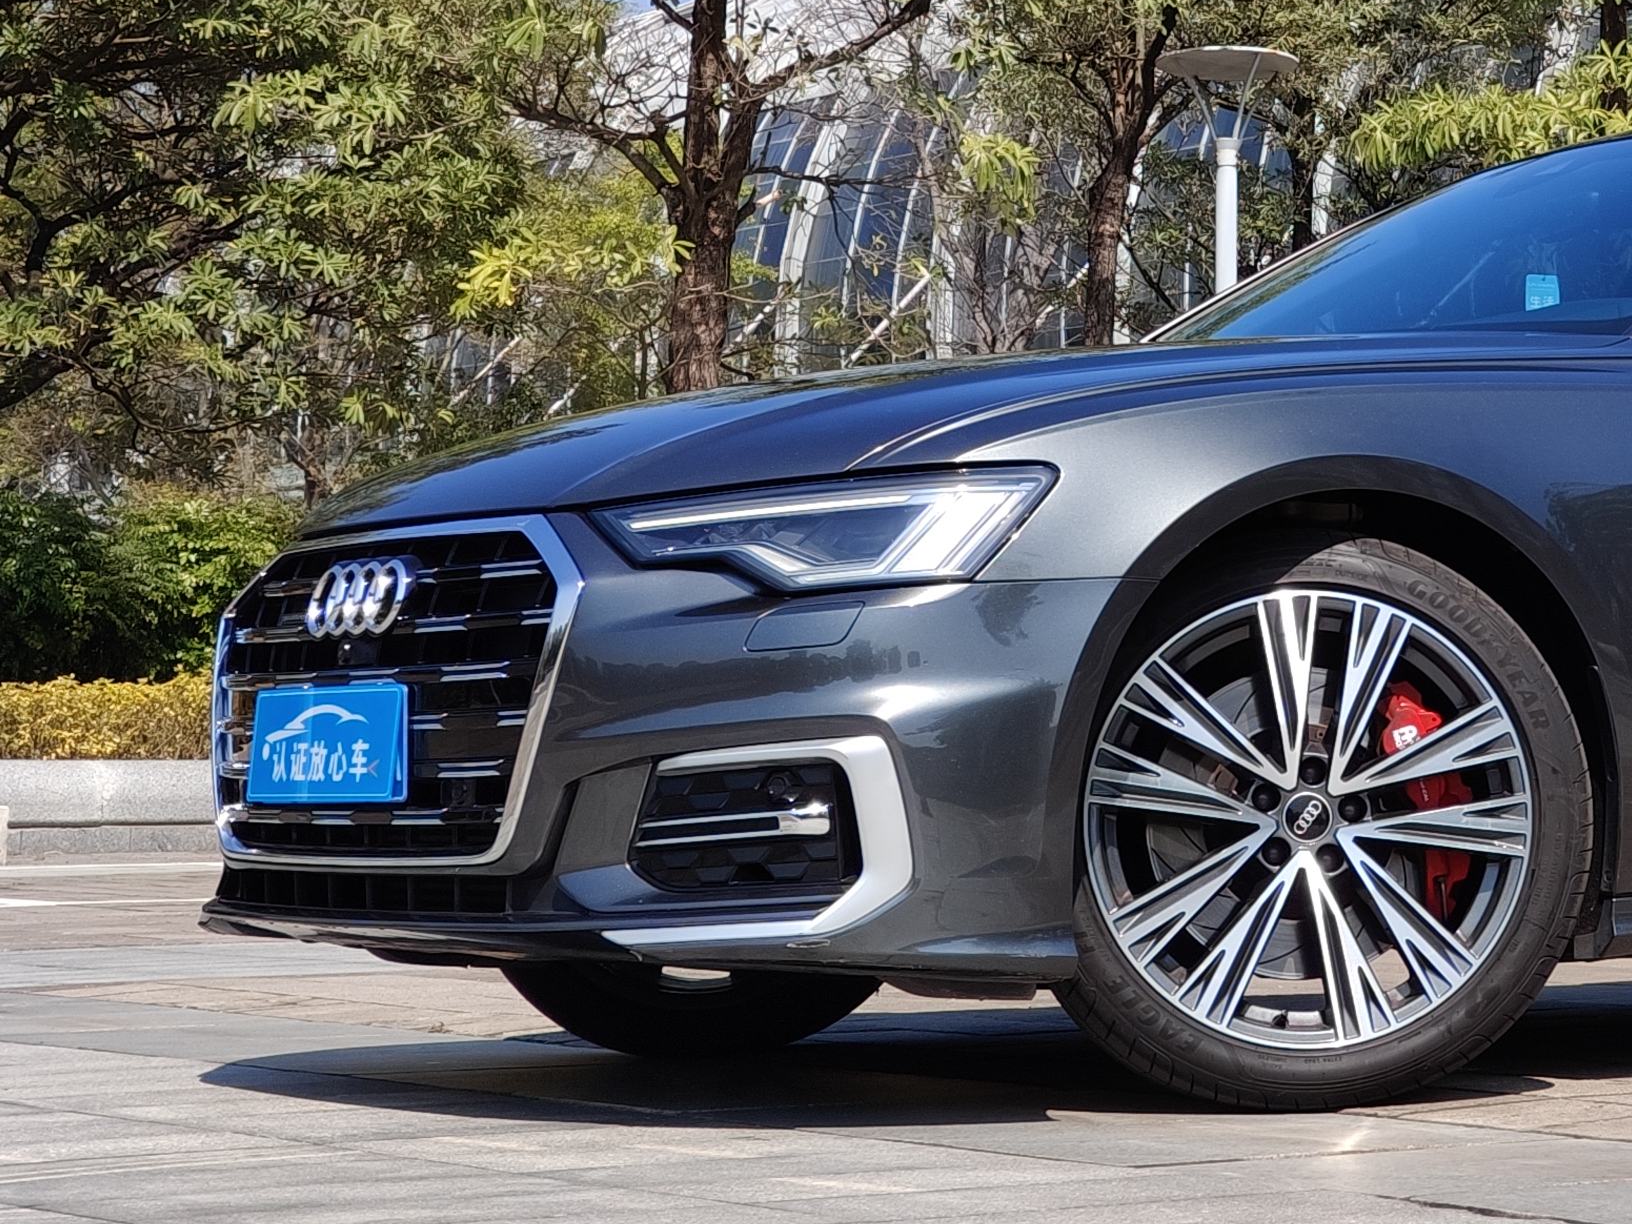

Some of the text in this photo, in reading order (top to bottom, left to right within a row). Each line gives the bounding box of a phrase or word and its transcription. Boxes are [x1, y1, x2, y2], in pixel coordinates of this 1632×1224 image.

[1406, 578, 1551, 731] GOODYEAR
[272, 738, 370, 783] 认证放心车
[1105, 974, 1202, 1053] EAGLE
